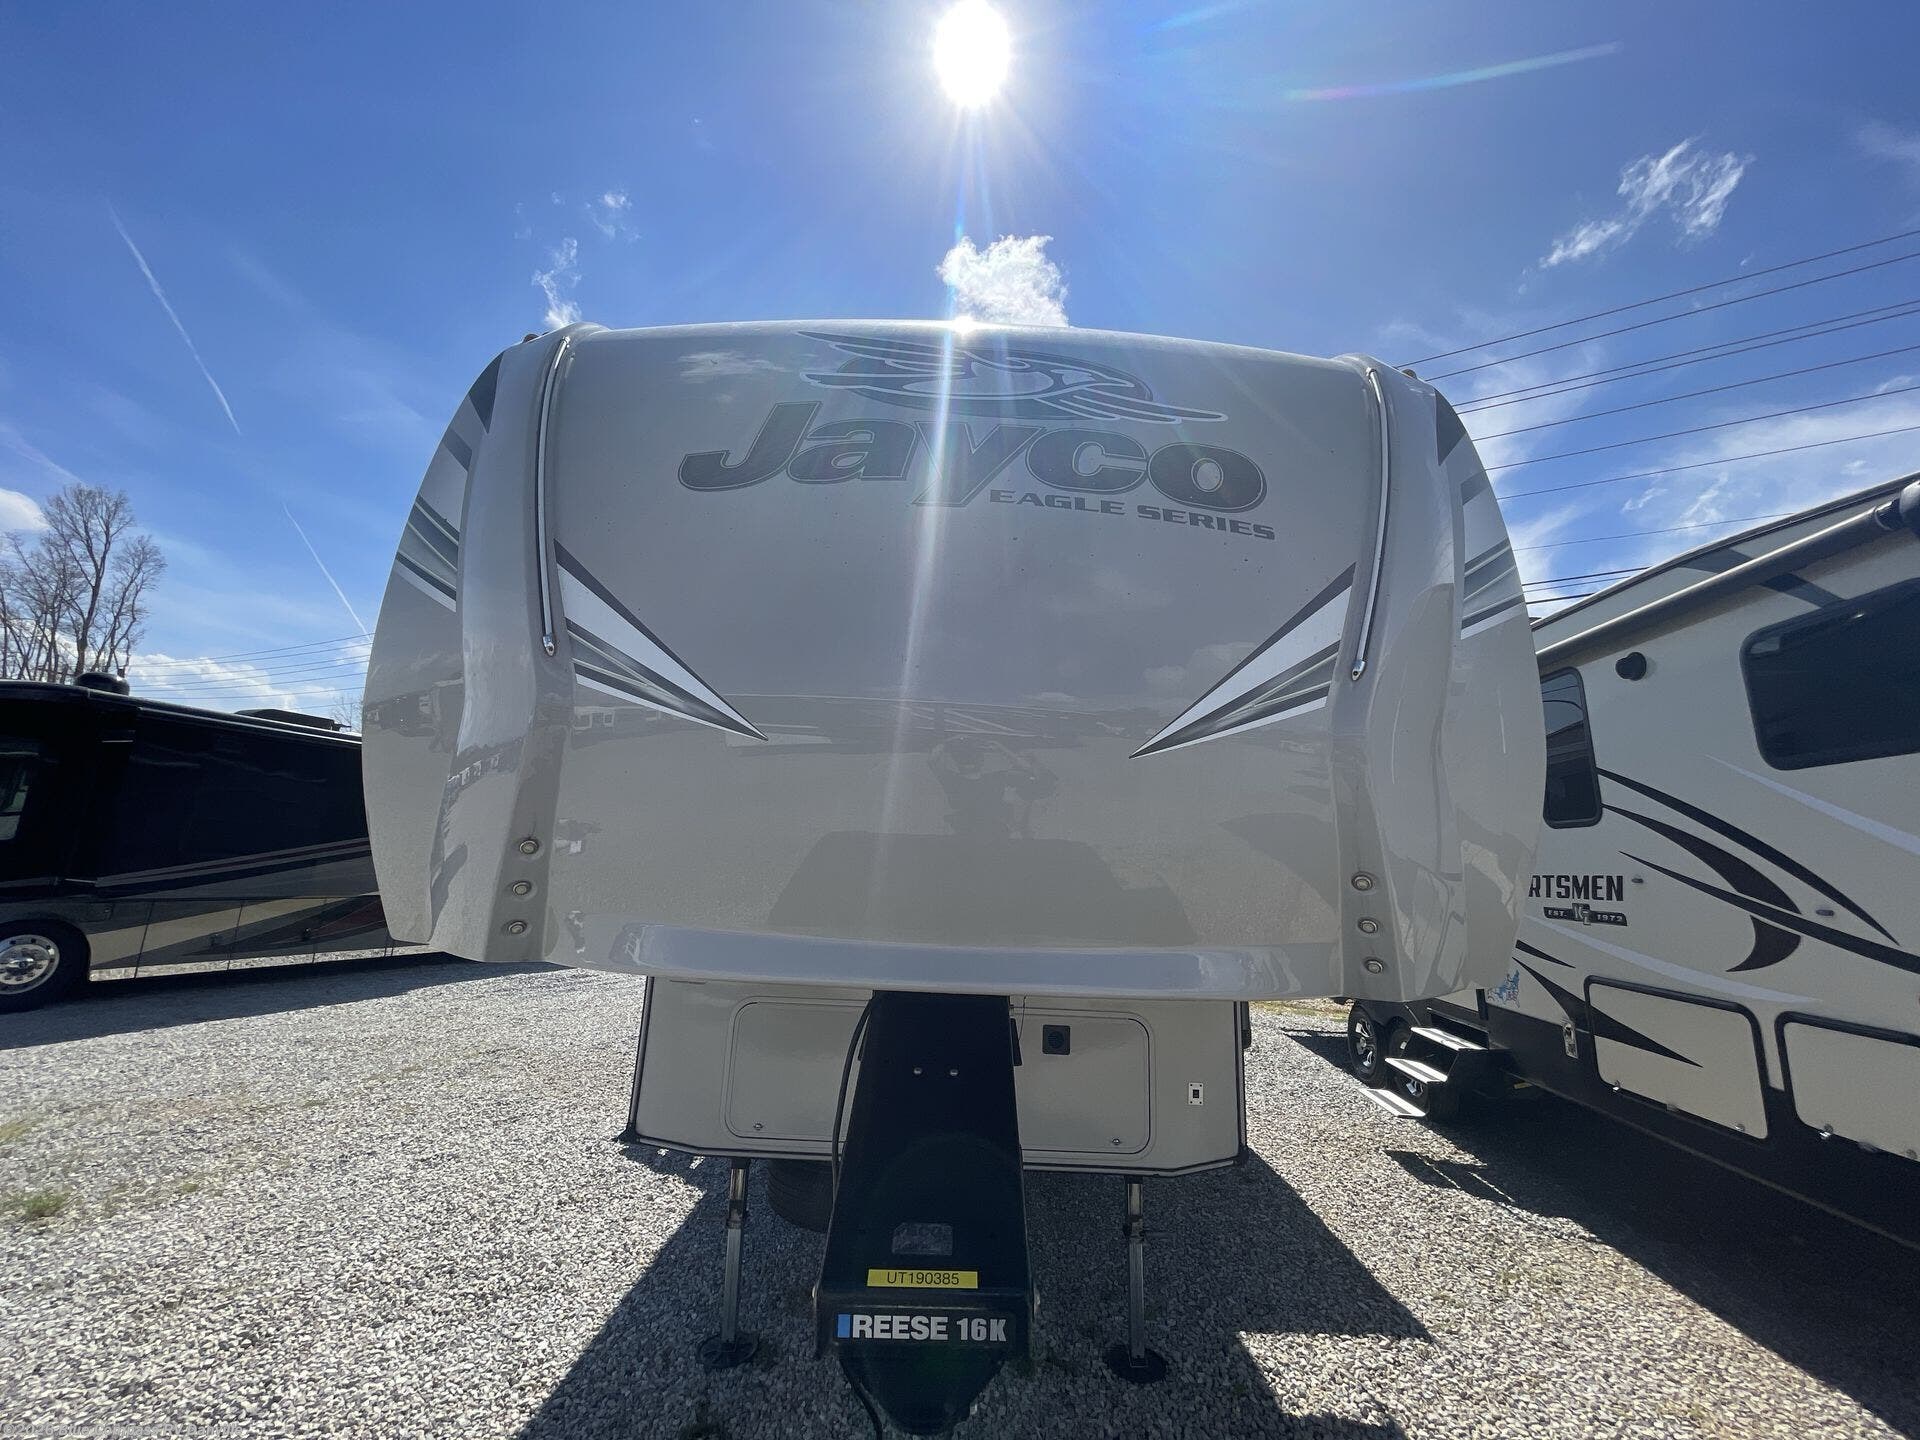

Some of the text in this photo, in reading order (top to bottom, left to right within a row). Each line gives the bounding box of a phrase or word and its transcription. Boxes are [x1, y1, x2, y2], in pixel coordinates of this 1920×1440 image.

[677, 401, 1269, 513] Jayco
[989, 488, 1276, 541] EAGLE SERIES
[1528, 874, 1624, 901] RTSMEN
[1597, 913, 1623, 923] 1972
[887, 1271, 960, 1285] UT190385
[852, 1314, 1007, 1342] REESE 16K
